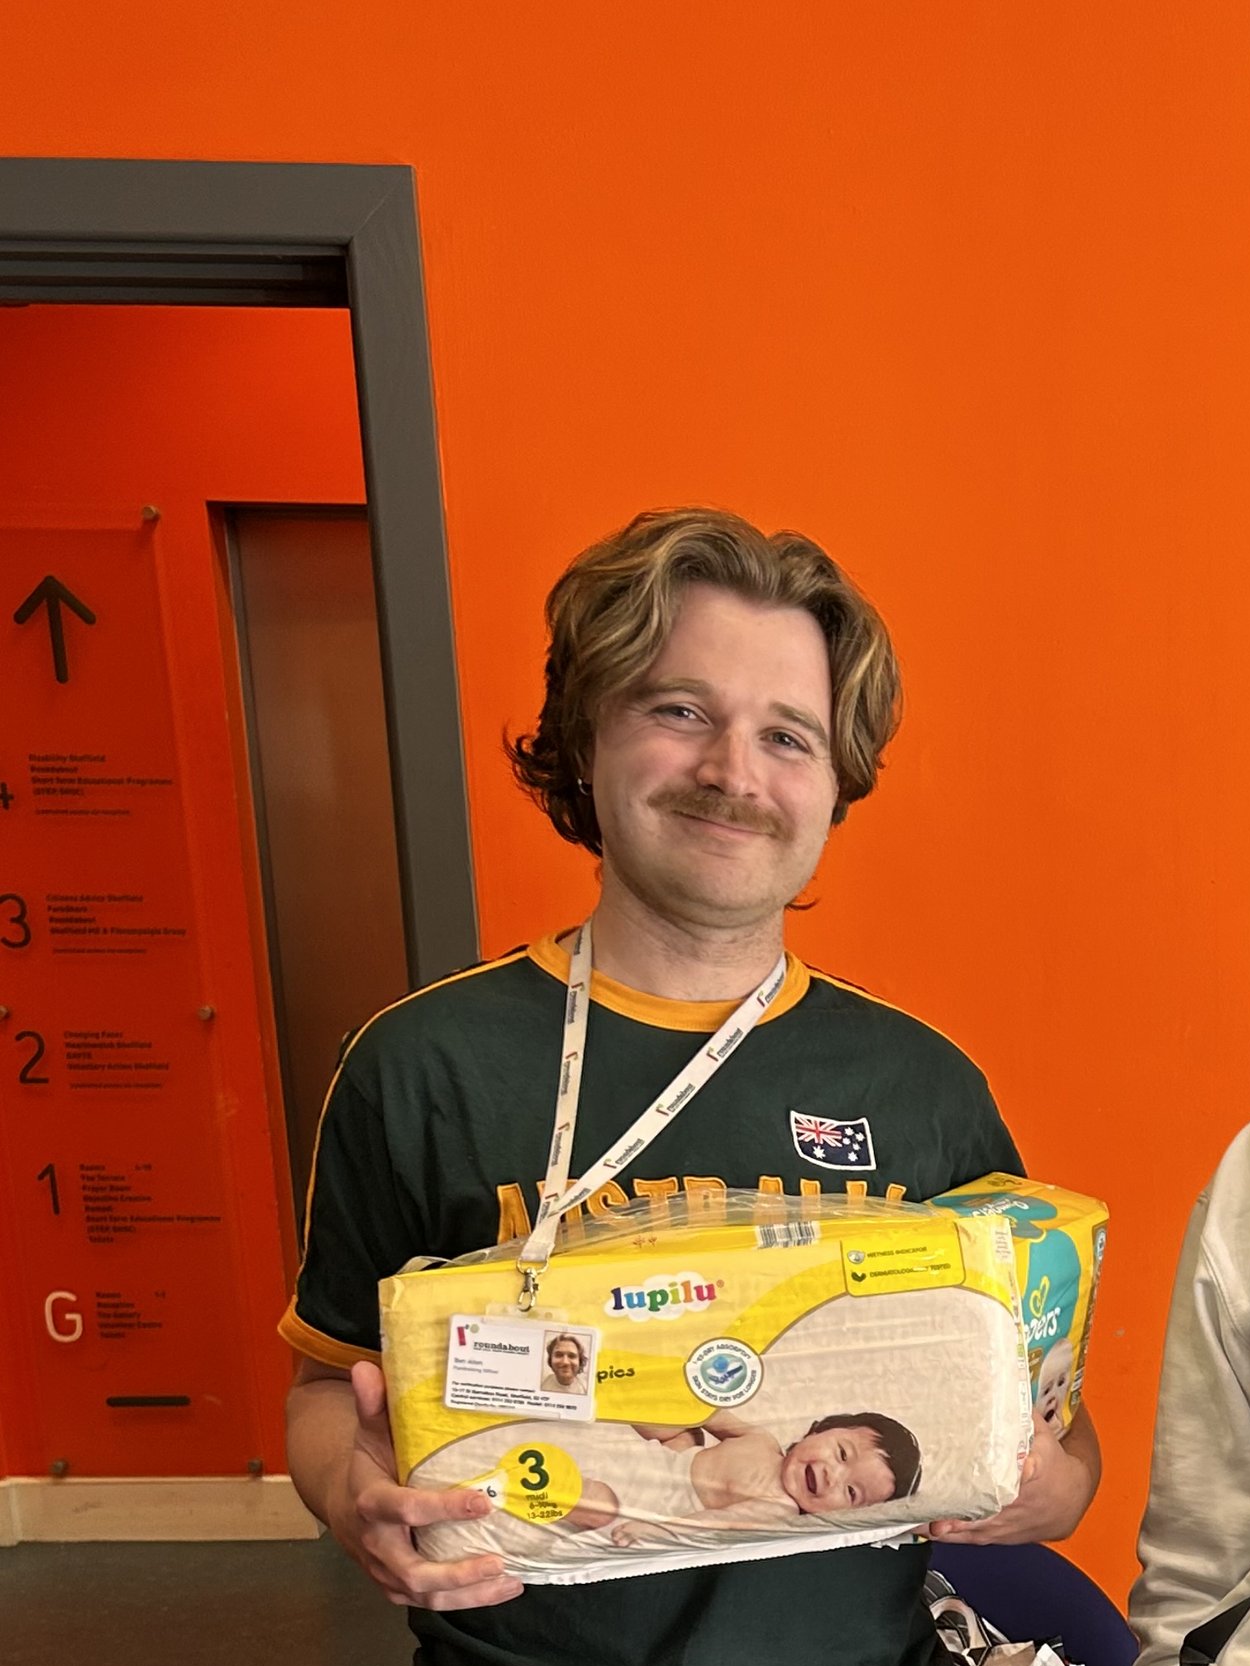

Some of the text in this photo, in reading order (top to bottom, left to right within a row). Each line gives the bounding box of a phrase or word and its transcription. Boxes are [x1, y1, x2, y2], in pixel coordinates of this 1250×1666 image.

[0, 893, 32, 949] 3
[15, 1031, 49, 1084] 2
[37, 1163, 60, 1216] 1
[611, 1278, 718, 1312] lupilu
[44, 1291, 83, 1343] G
[473, 1341, 530, 1353] roundabout
[518, 1449, 550, 1491] 3
[486, 1486, 497, 1498] 6
[526, 1492, 549, 1501] midi
